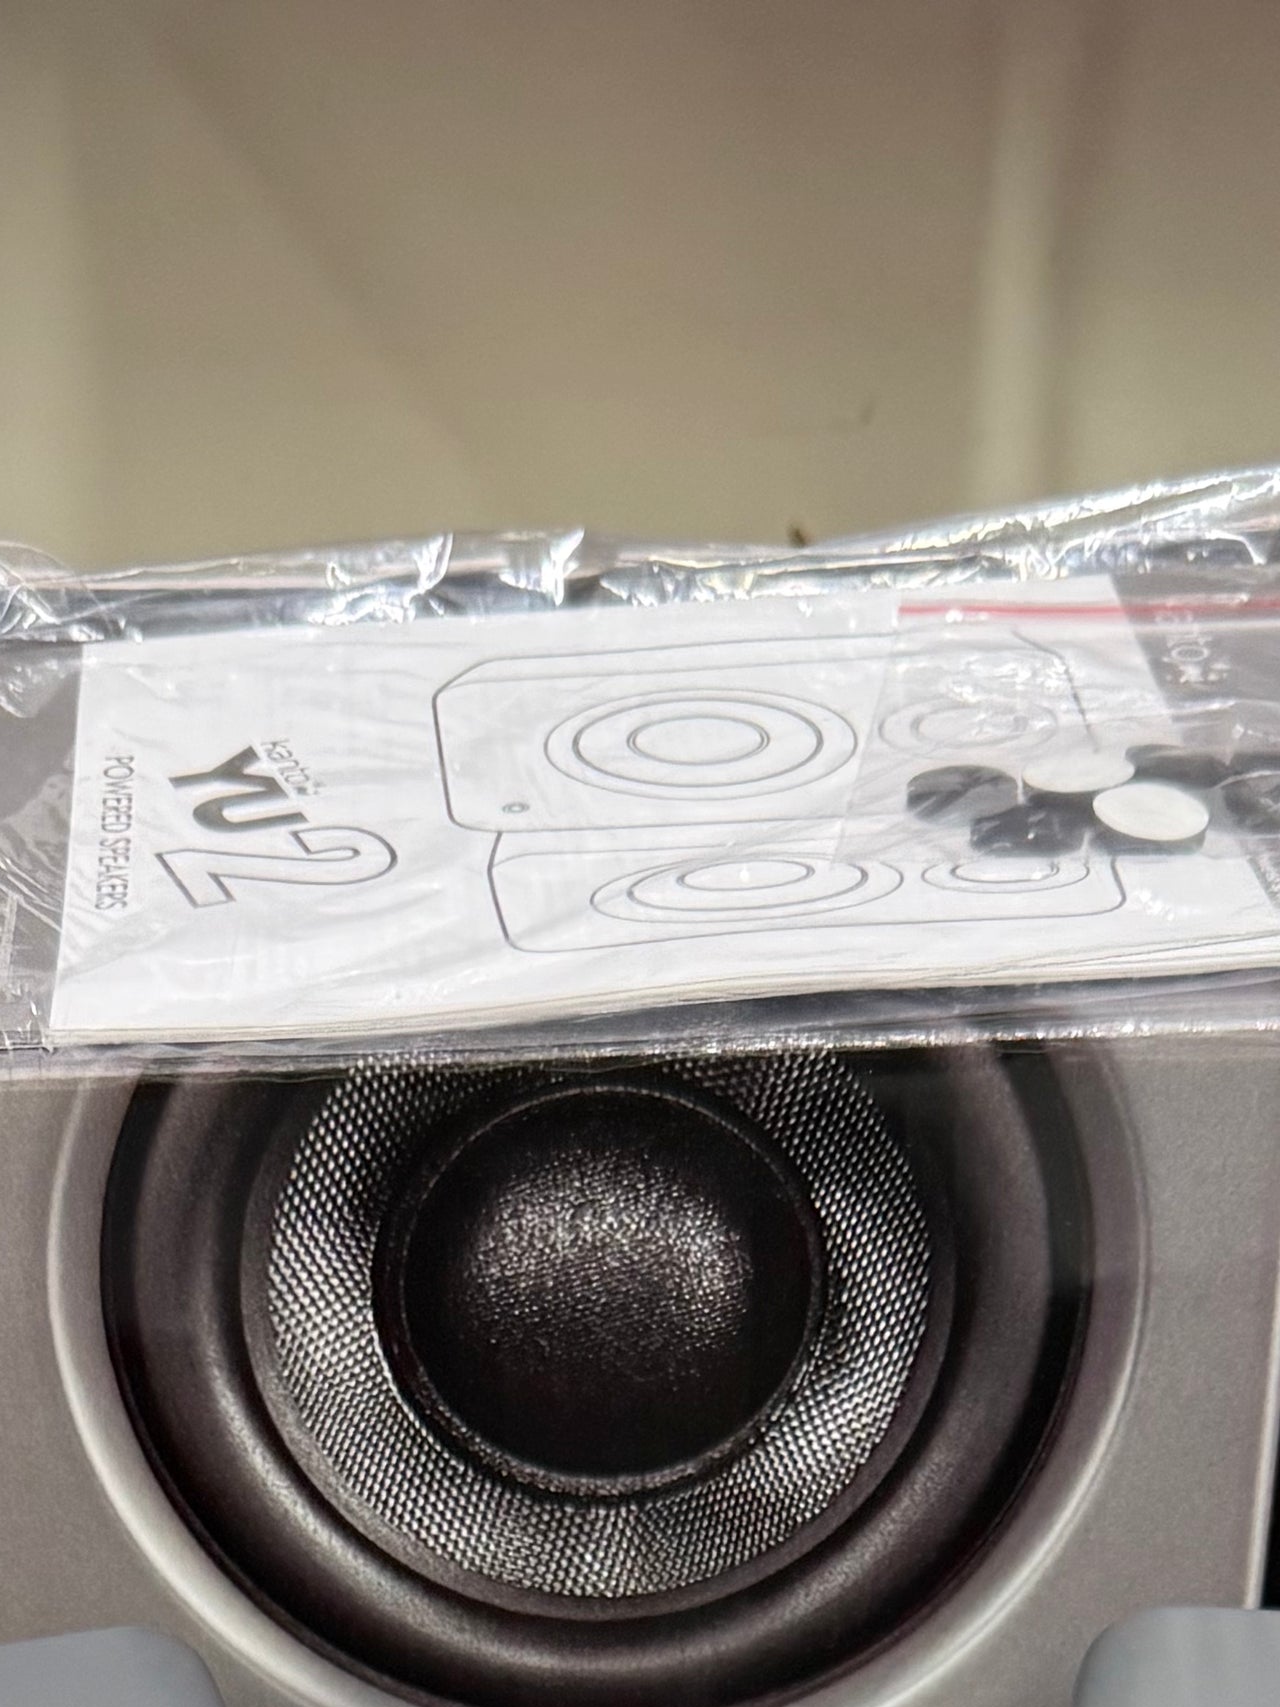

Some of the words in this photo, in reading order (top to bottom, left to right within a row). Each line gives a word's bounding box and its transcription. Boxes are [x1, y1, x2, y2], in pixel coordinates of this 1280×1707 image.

[101, 755, 135, 834] POWERED
[260, 738, 312, 787] kanto
[155, 743, 399, 909] YU2
[94, 837, 132, 910] SPEAKERS
